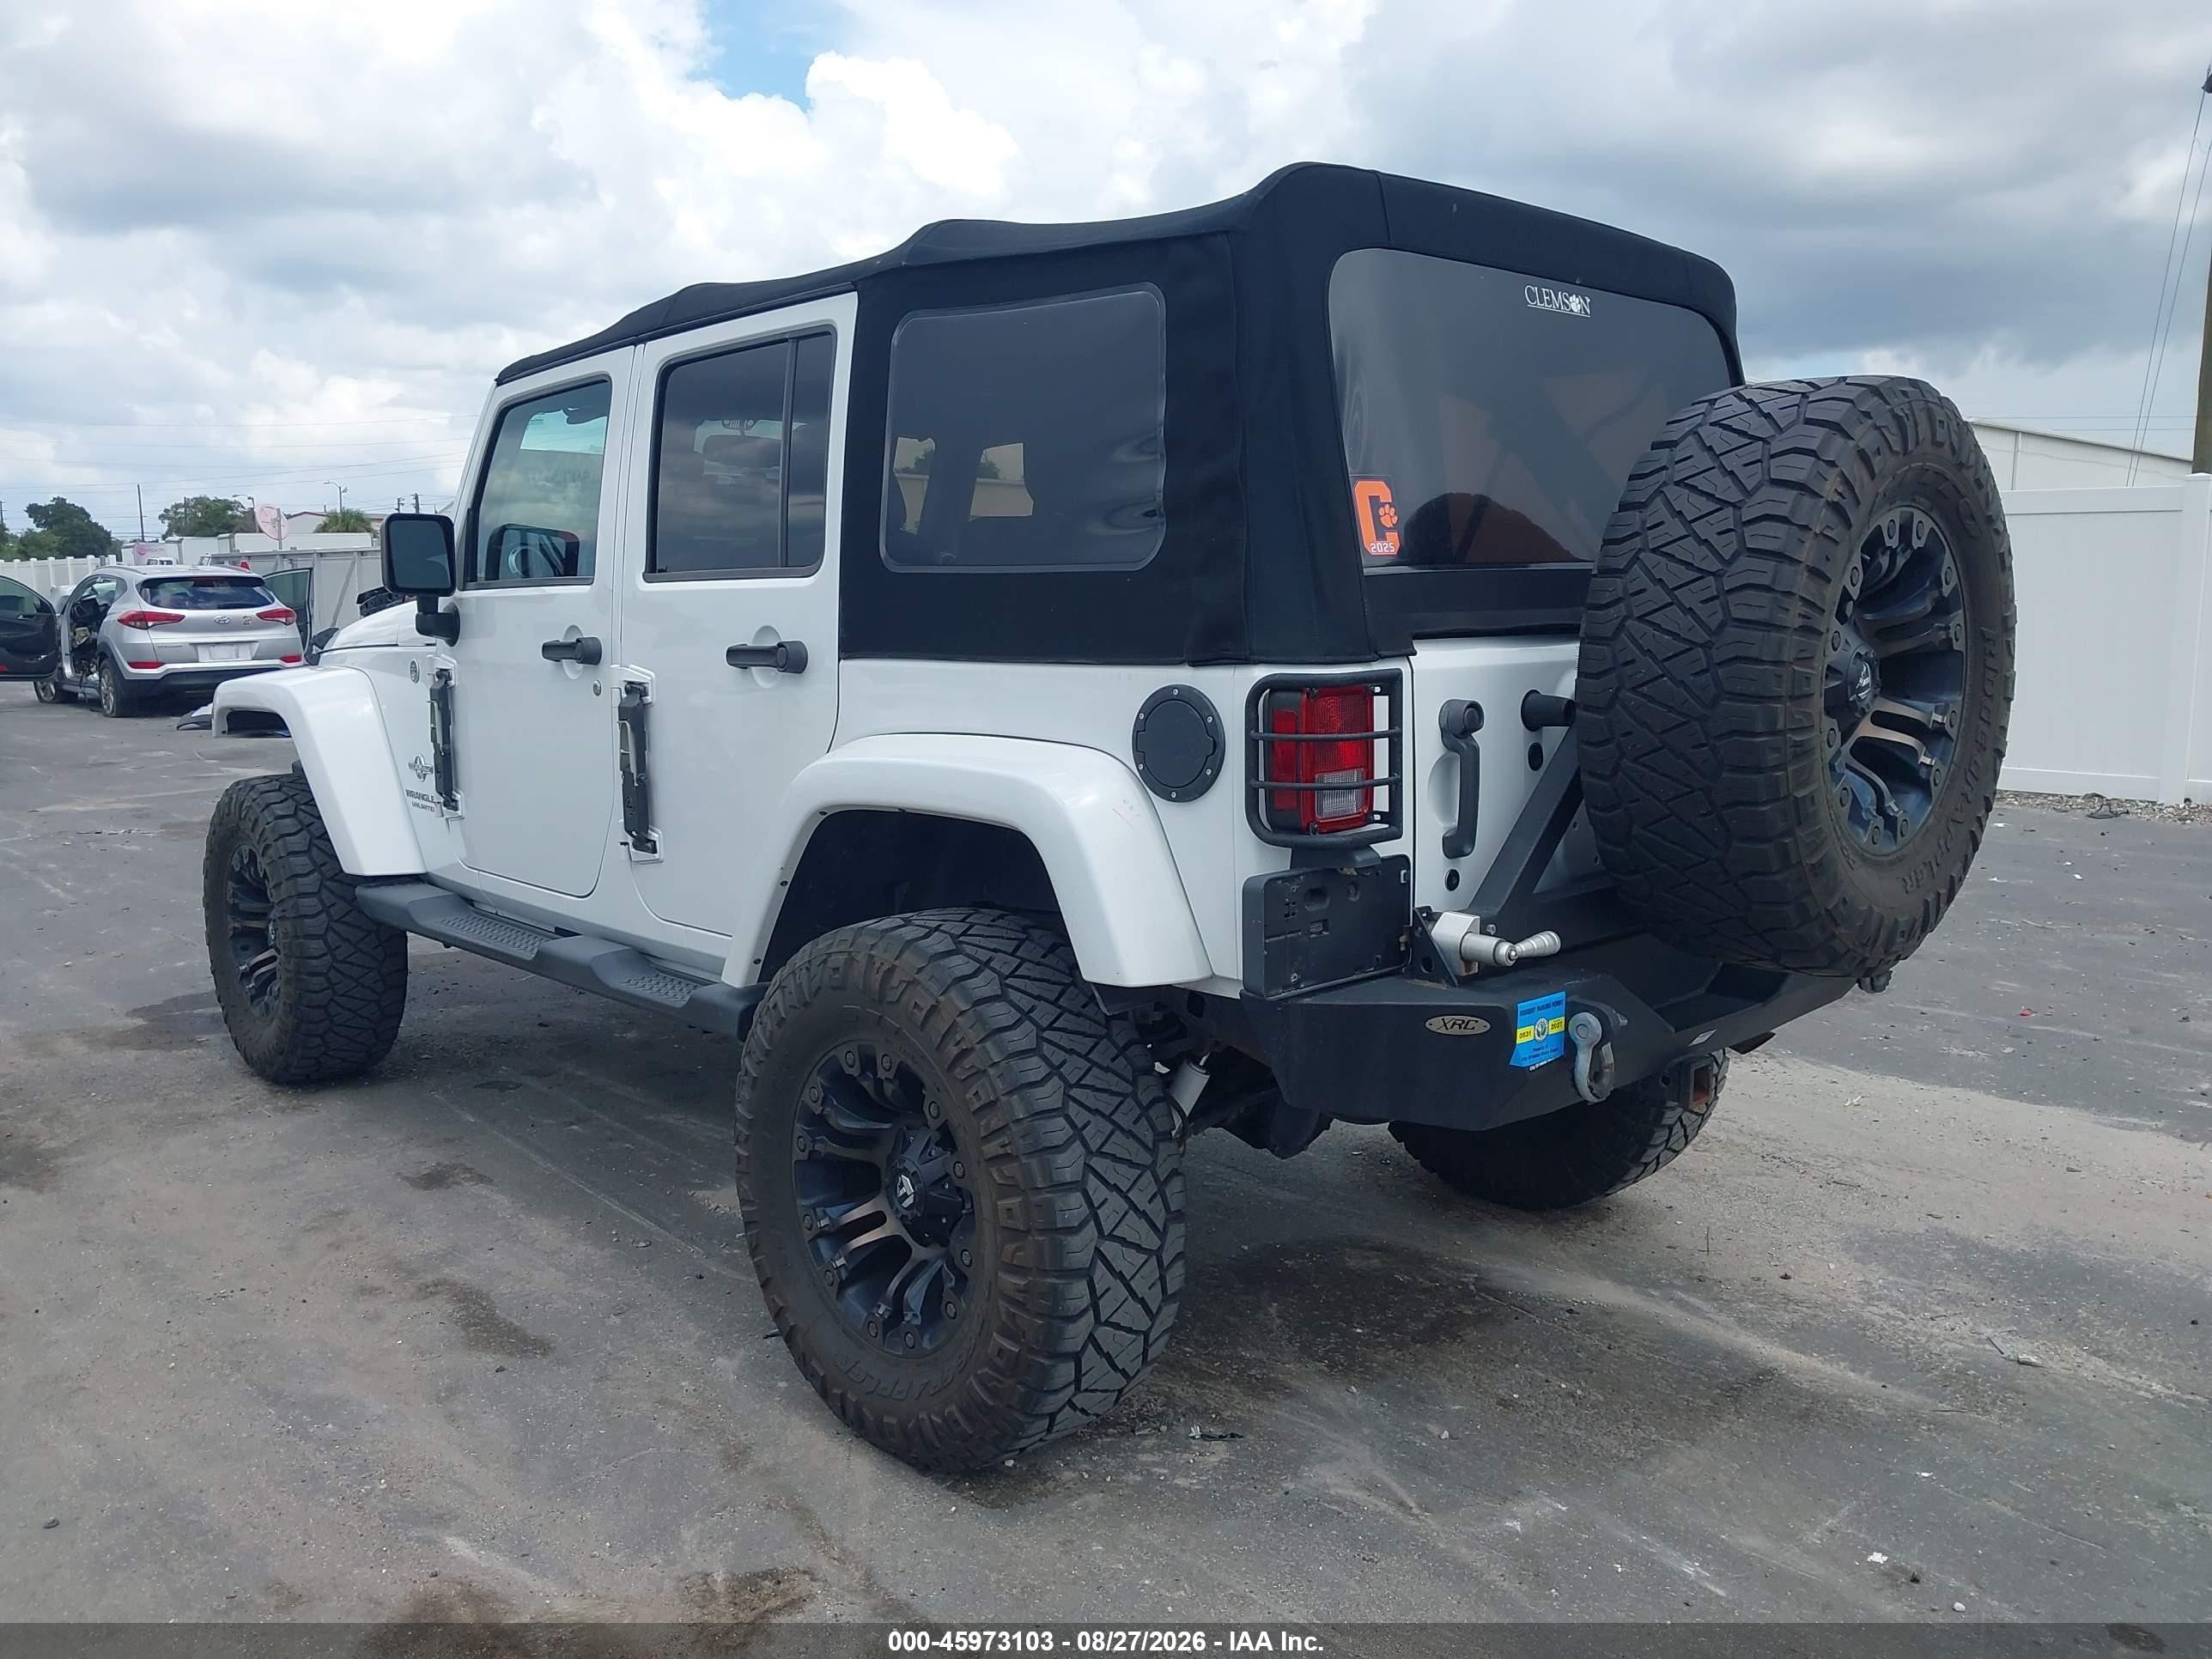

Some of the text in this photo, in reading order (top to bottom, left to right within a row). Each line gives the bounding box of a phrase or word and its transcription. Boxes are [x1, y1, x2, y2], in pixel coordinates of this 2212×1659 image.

[1370, 543, 1395, 553] 2025
[405, 788, 434, 804] WRANGLE
[1435, 1018, 1479, 1030] XRC
